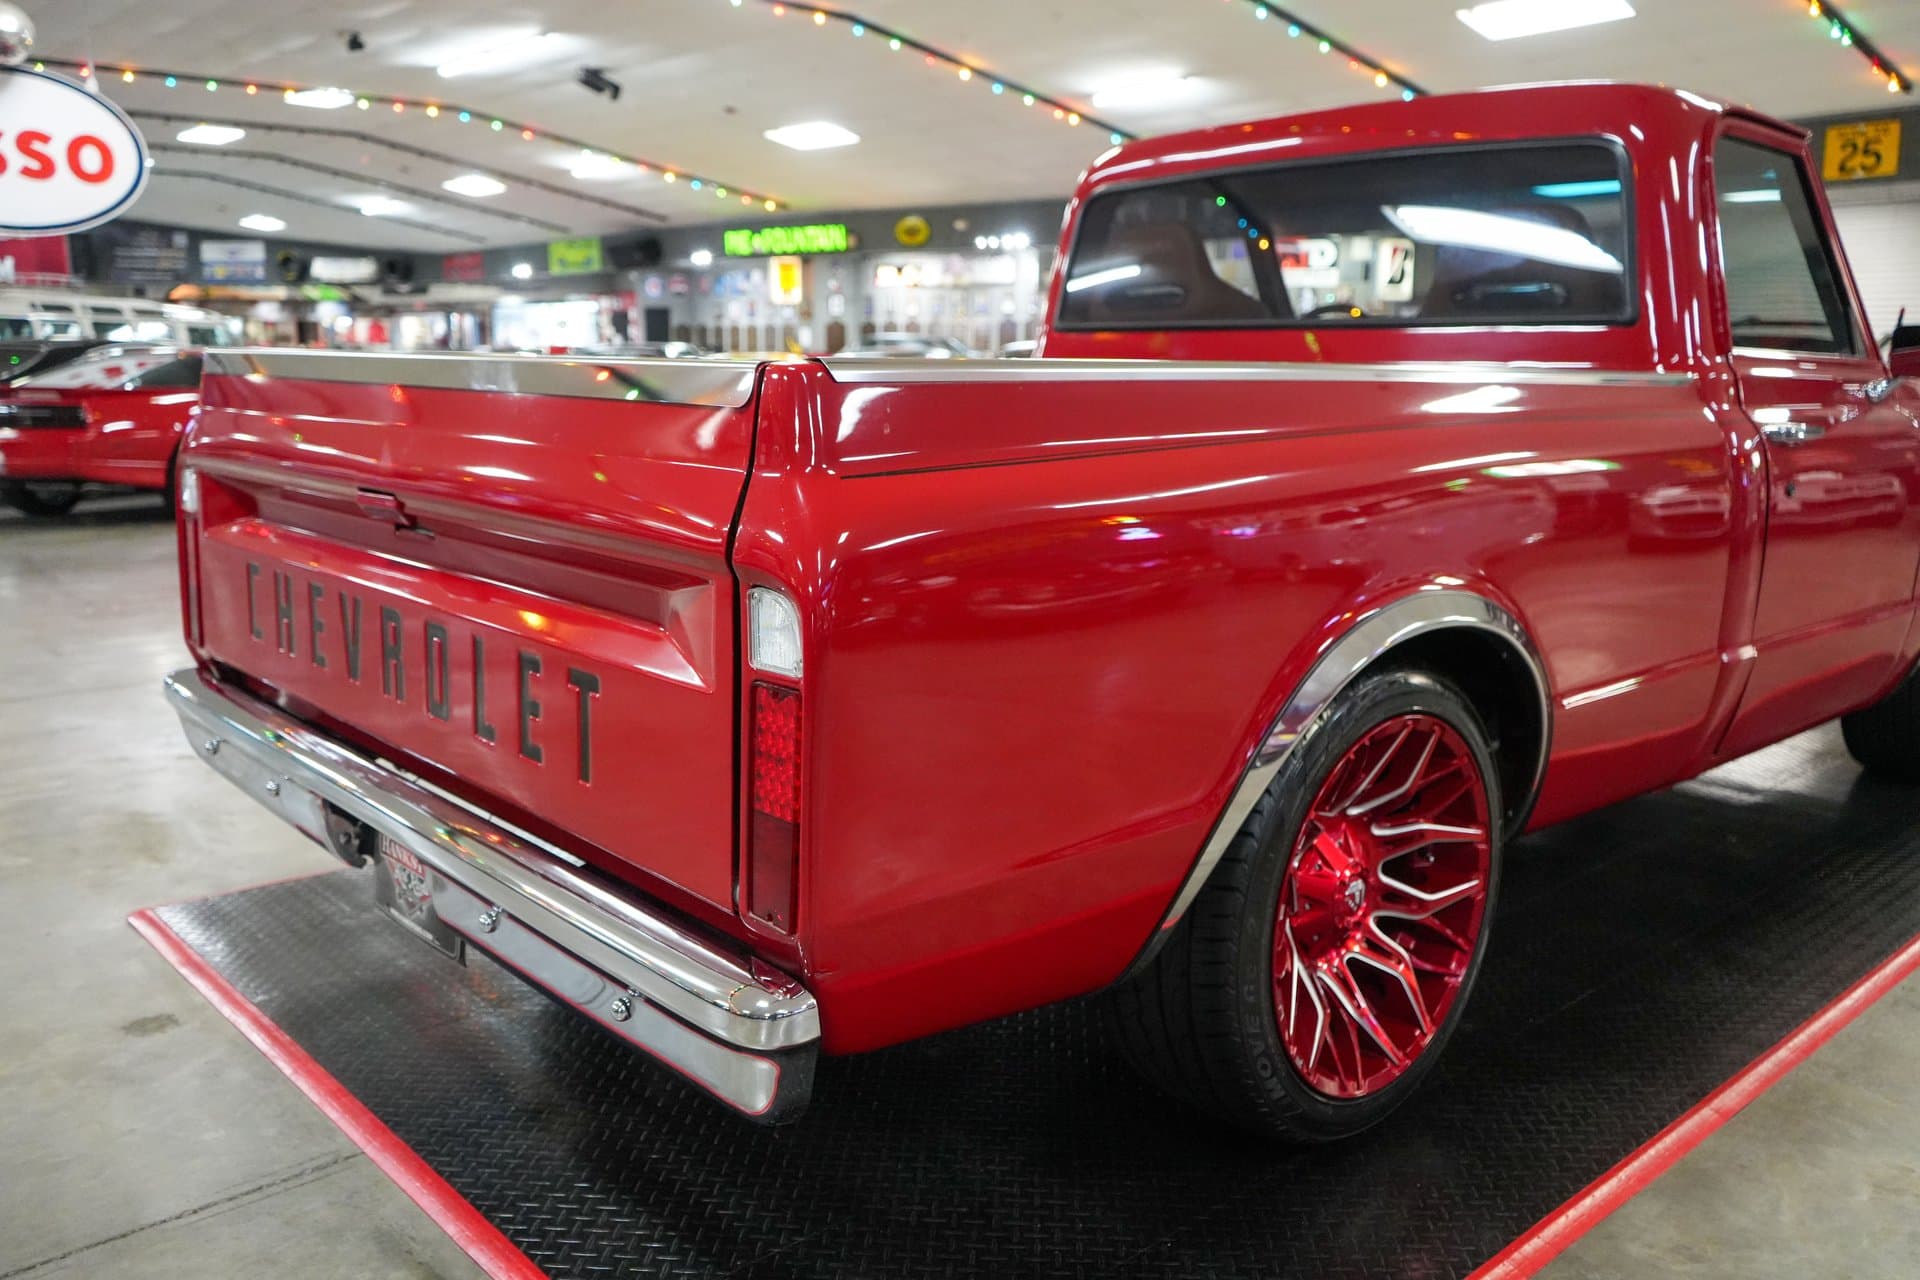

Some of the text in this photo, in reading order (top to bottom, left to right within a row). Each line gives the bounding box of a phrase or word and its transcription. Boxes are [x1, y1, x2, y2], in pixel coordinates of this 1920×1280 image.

[0, 130, 115, 184] SO
[1838, 138, 1883, 178] 25
[247, 561, 601, 787] CHEVROLET
